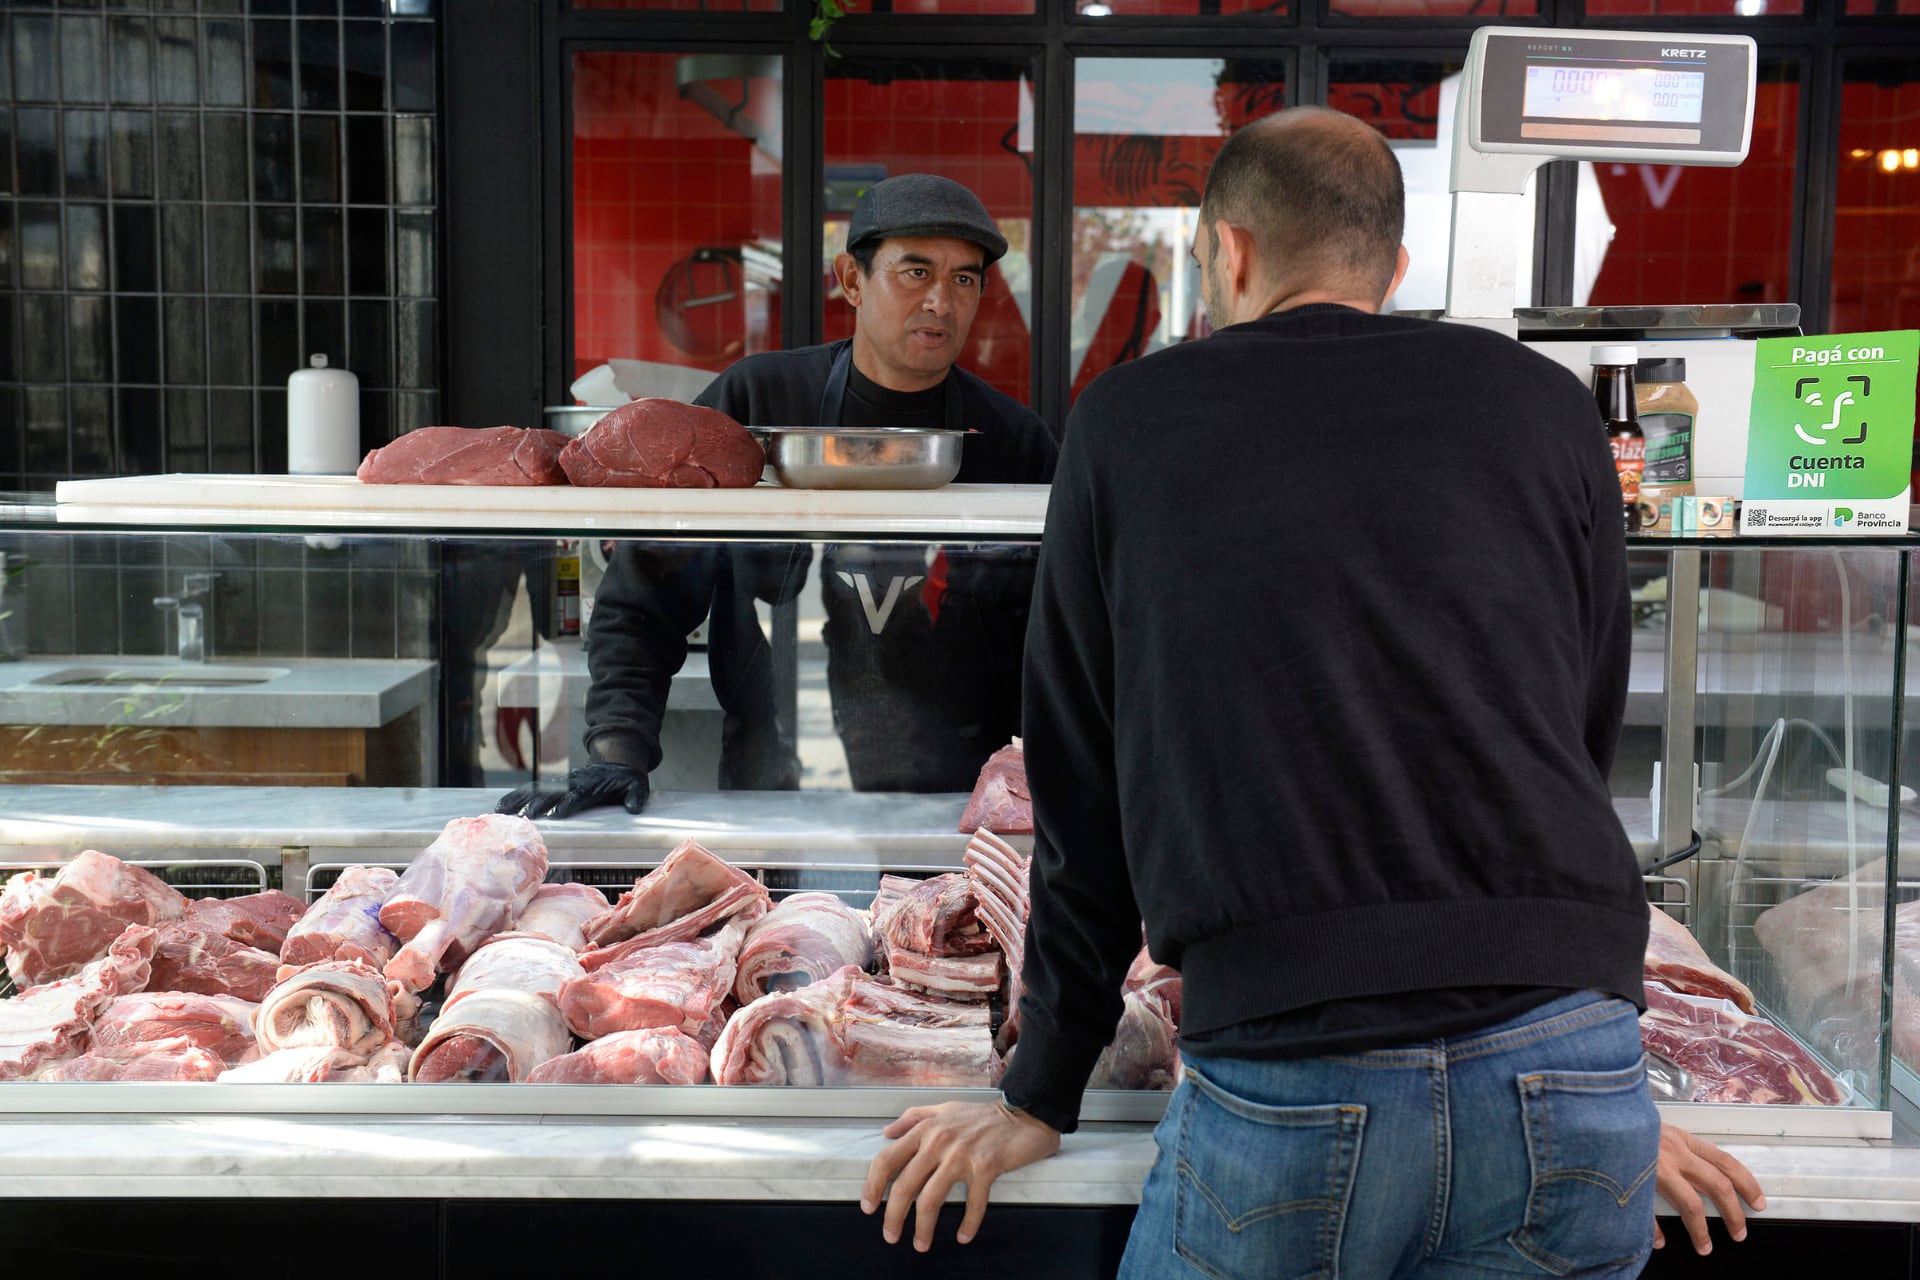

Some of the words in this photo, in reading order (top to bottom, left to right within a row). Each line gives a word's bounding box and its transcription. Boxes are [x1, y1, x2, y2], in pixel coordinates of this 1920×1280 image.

[1661, 48, 1707, 58] KRETZ
[1654, 73, 1681, 88] 0.00
[1652, 93, 1679, 107] 0.00
[1791, 345, 1842, 366] Pagá
[1847, 346, 1884, 360] con
[1789, 454, 1865, 470] Cuenta
[1787, 472, 1826, 488] DNI
[1857, 511, 1886, 519] Banco
[1857, 519, 1901, 527] Provincia
